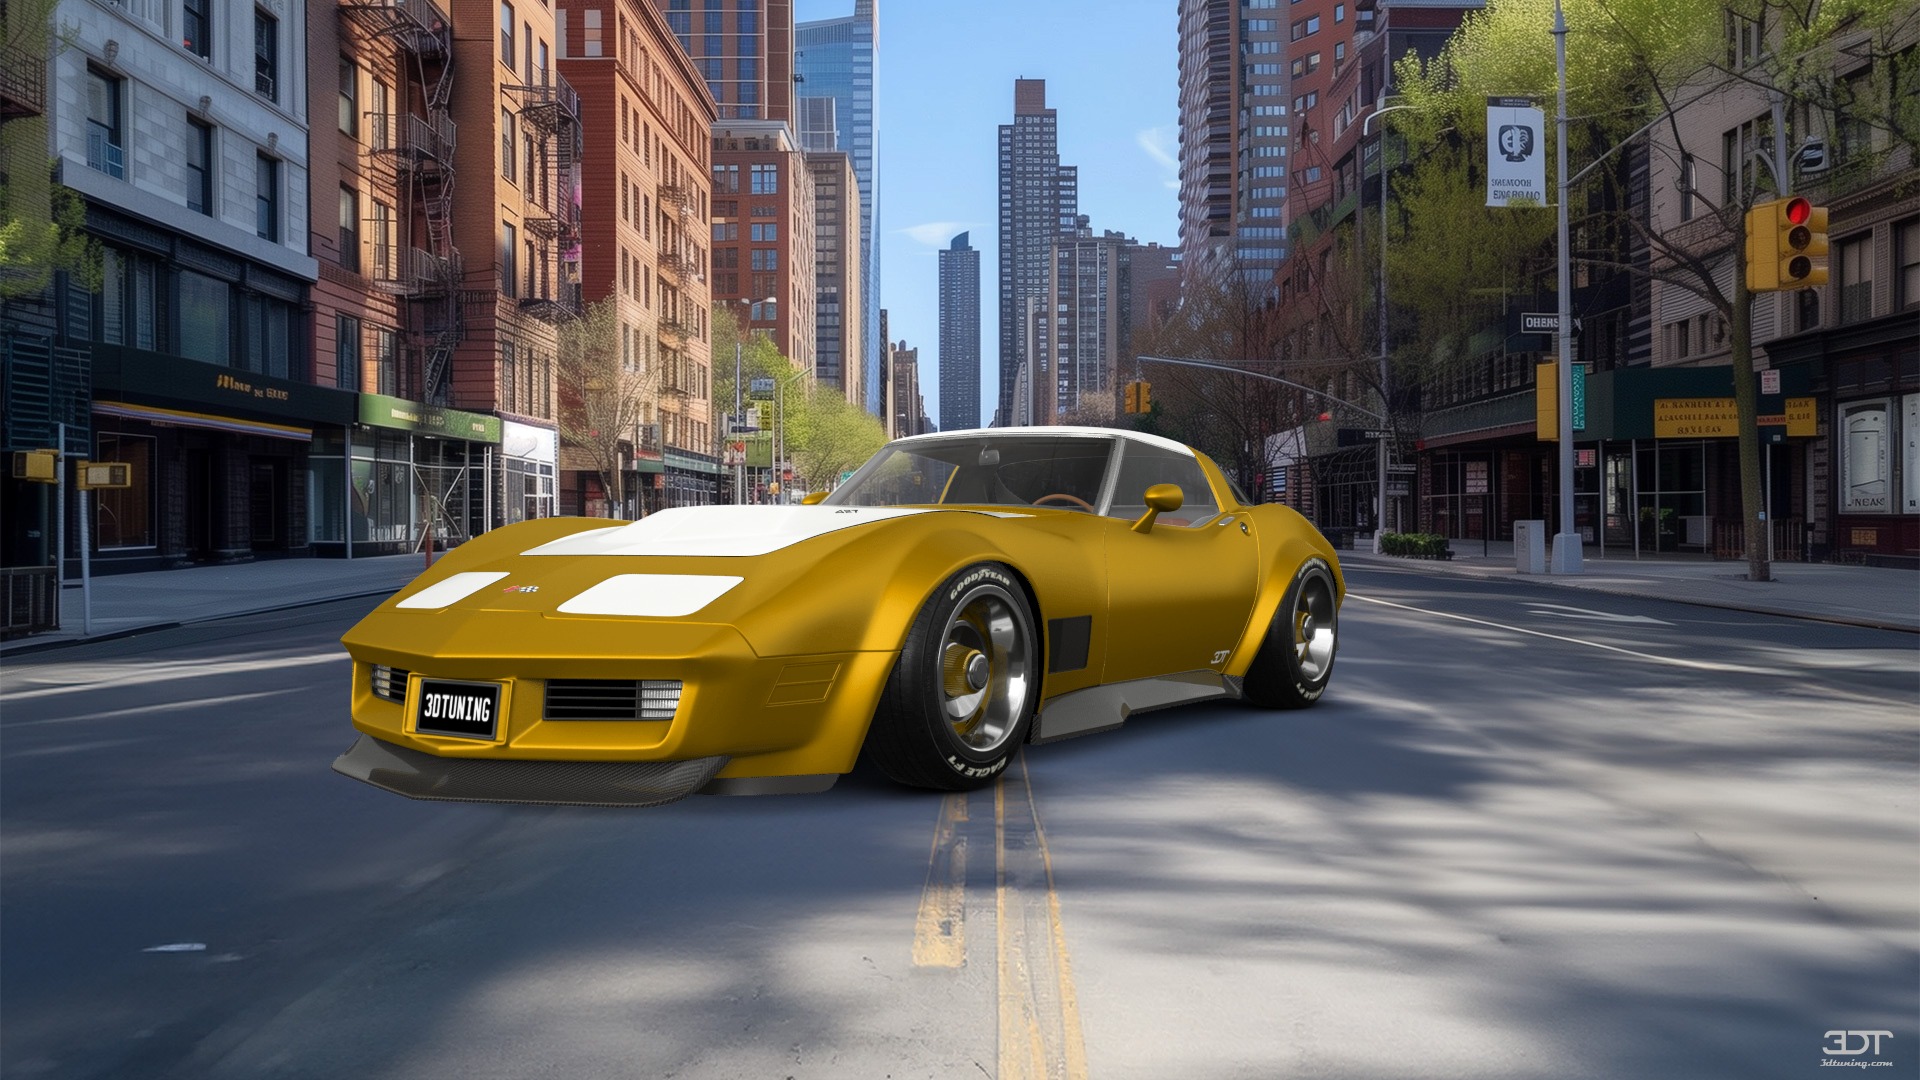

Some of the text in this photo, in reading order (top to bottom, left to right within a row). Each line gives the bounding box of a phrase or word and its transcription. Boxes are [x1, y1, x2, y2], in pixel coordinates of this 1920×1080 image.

[950, 568, 1010, 600] GOODYEAR
[424, 693, 491, 722] 3DTUNING
[947, 755, 1007, 777] EAGLE F1
